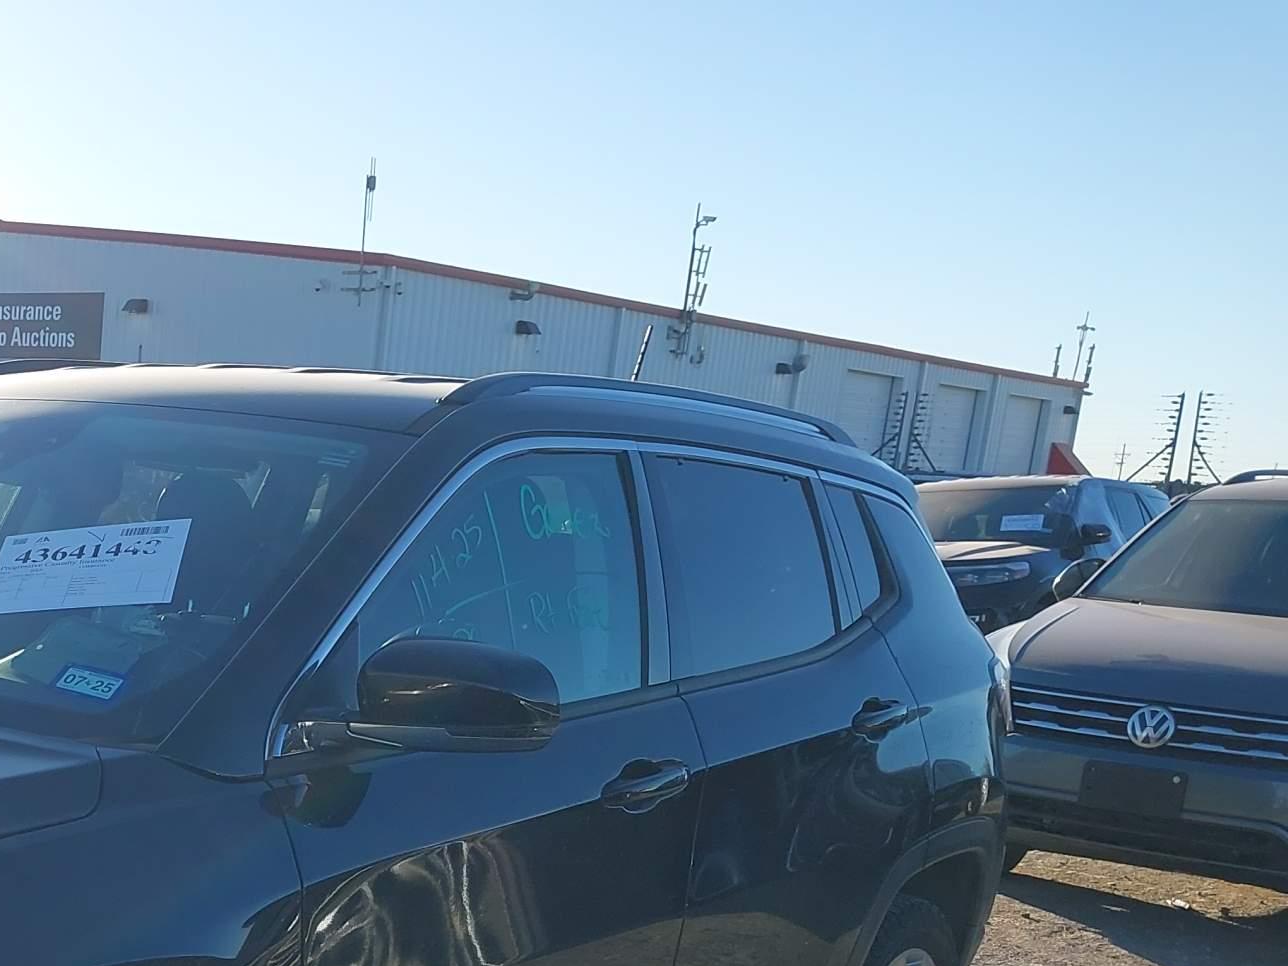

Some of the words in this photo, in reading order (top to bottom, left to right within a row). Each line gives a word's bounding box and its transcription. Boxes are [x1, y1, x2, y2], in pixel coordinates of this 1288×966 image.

[10, 326, 75, 348] Auctions
[63, 674, 87, 686] 07
[90, 680, 114, 693] 25
